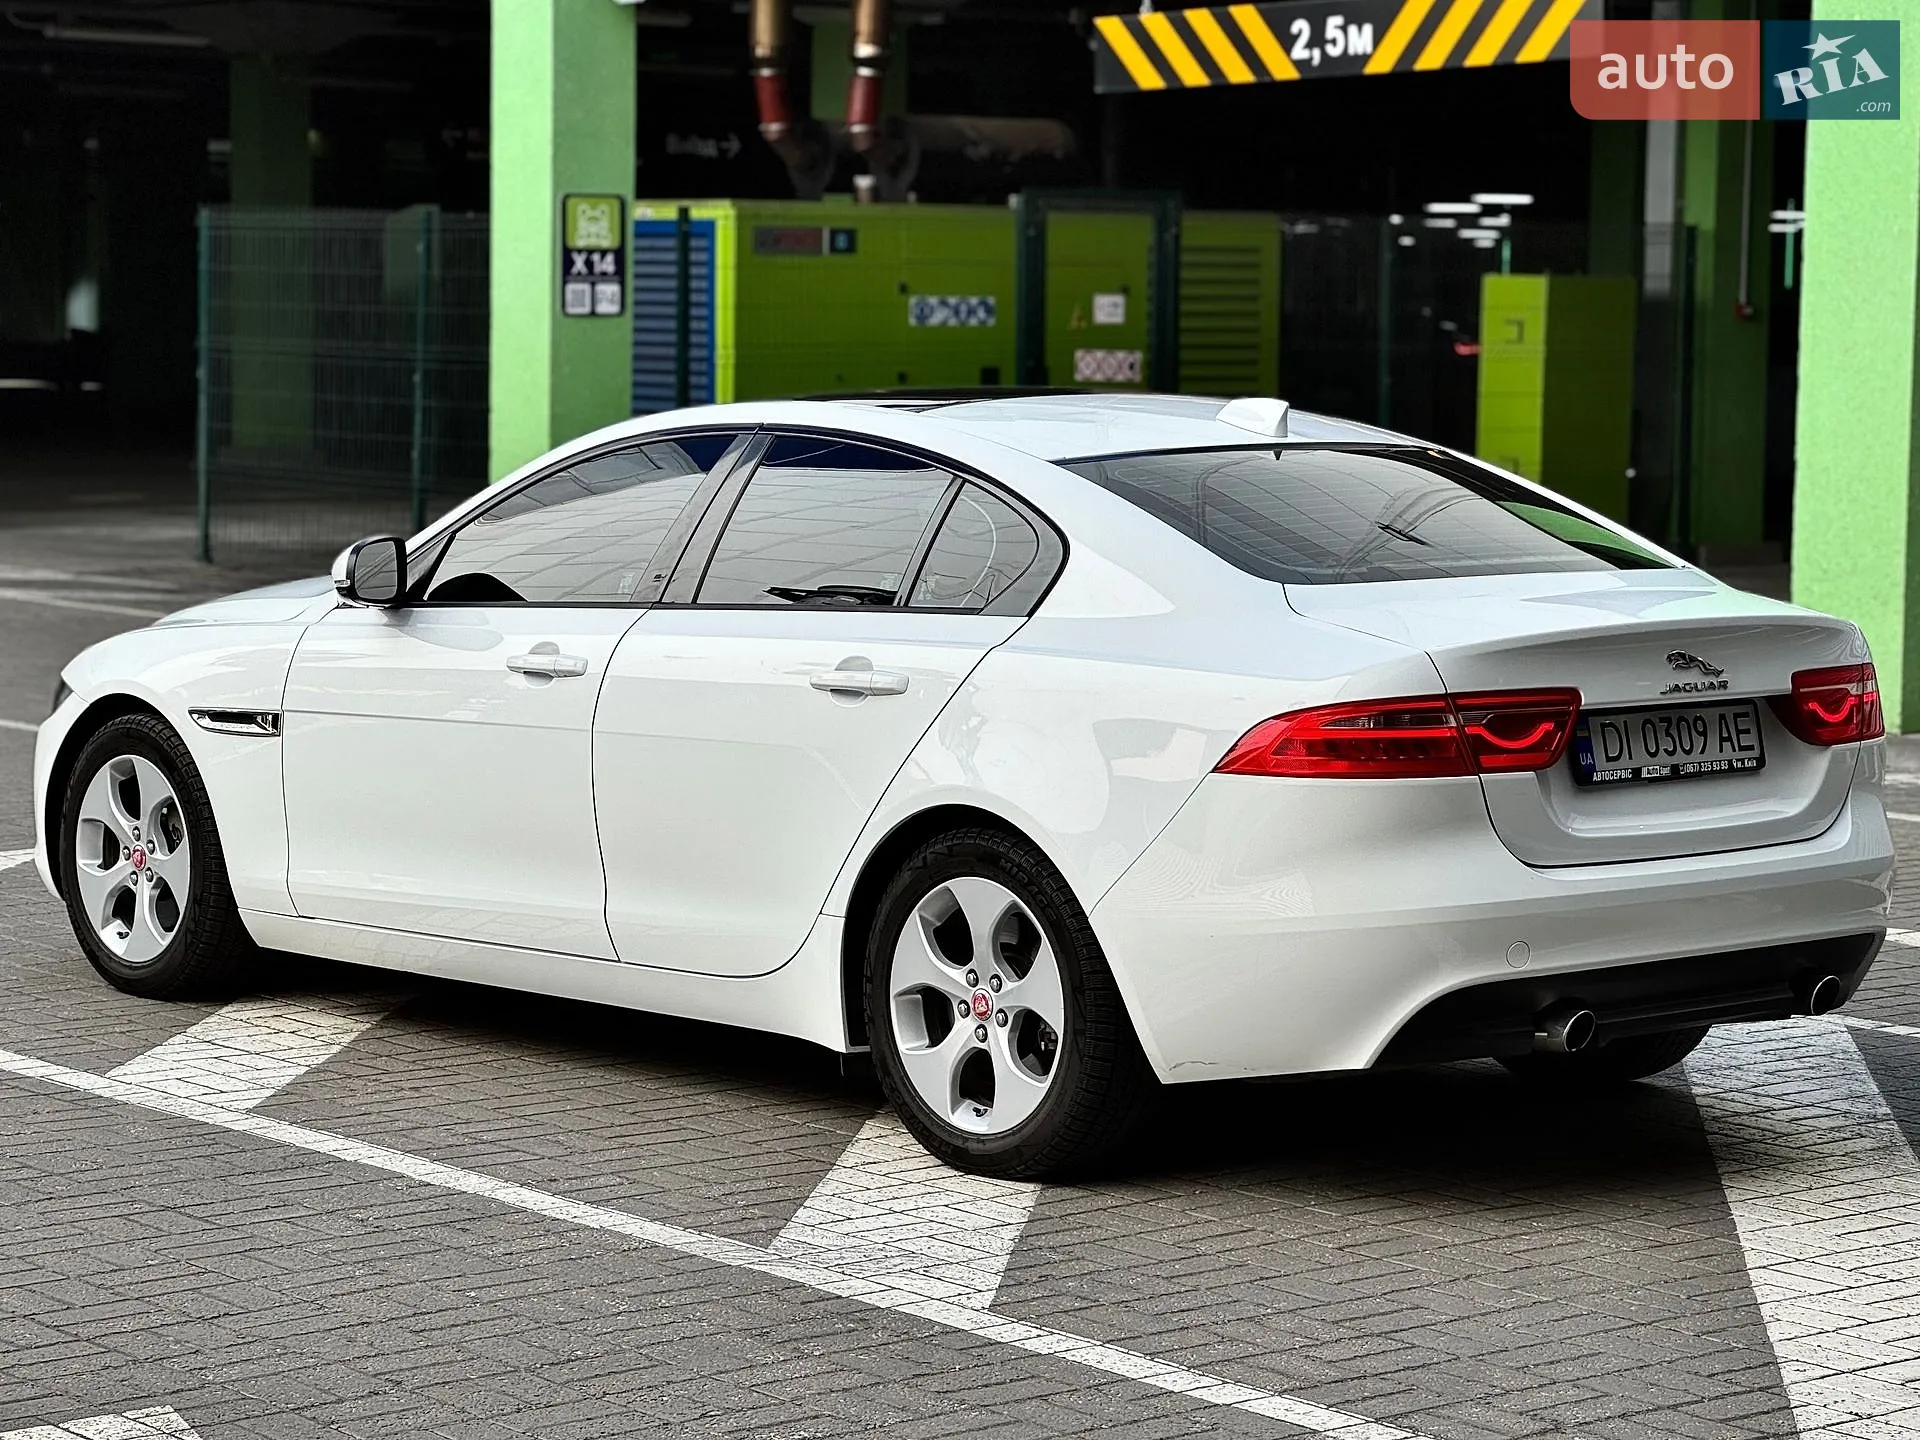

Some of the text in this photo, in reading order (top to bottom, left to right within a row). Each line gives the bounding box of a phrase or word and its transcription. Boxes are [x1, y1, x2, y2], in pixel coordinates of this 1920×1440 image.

[1660, 679, 1729, 695] JAGUAR
[1600, 711, 1756, 763] DI 0309 AE
[1580, 753, 1594, 765] UA
[1701, 761, 1711, 771] 325
[1593, 769, 1632, 782] АВТОСЕРВІС
